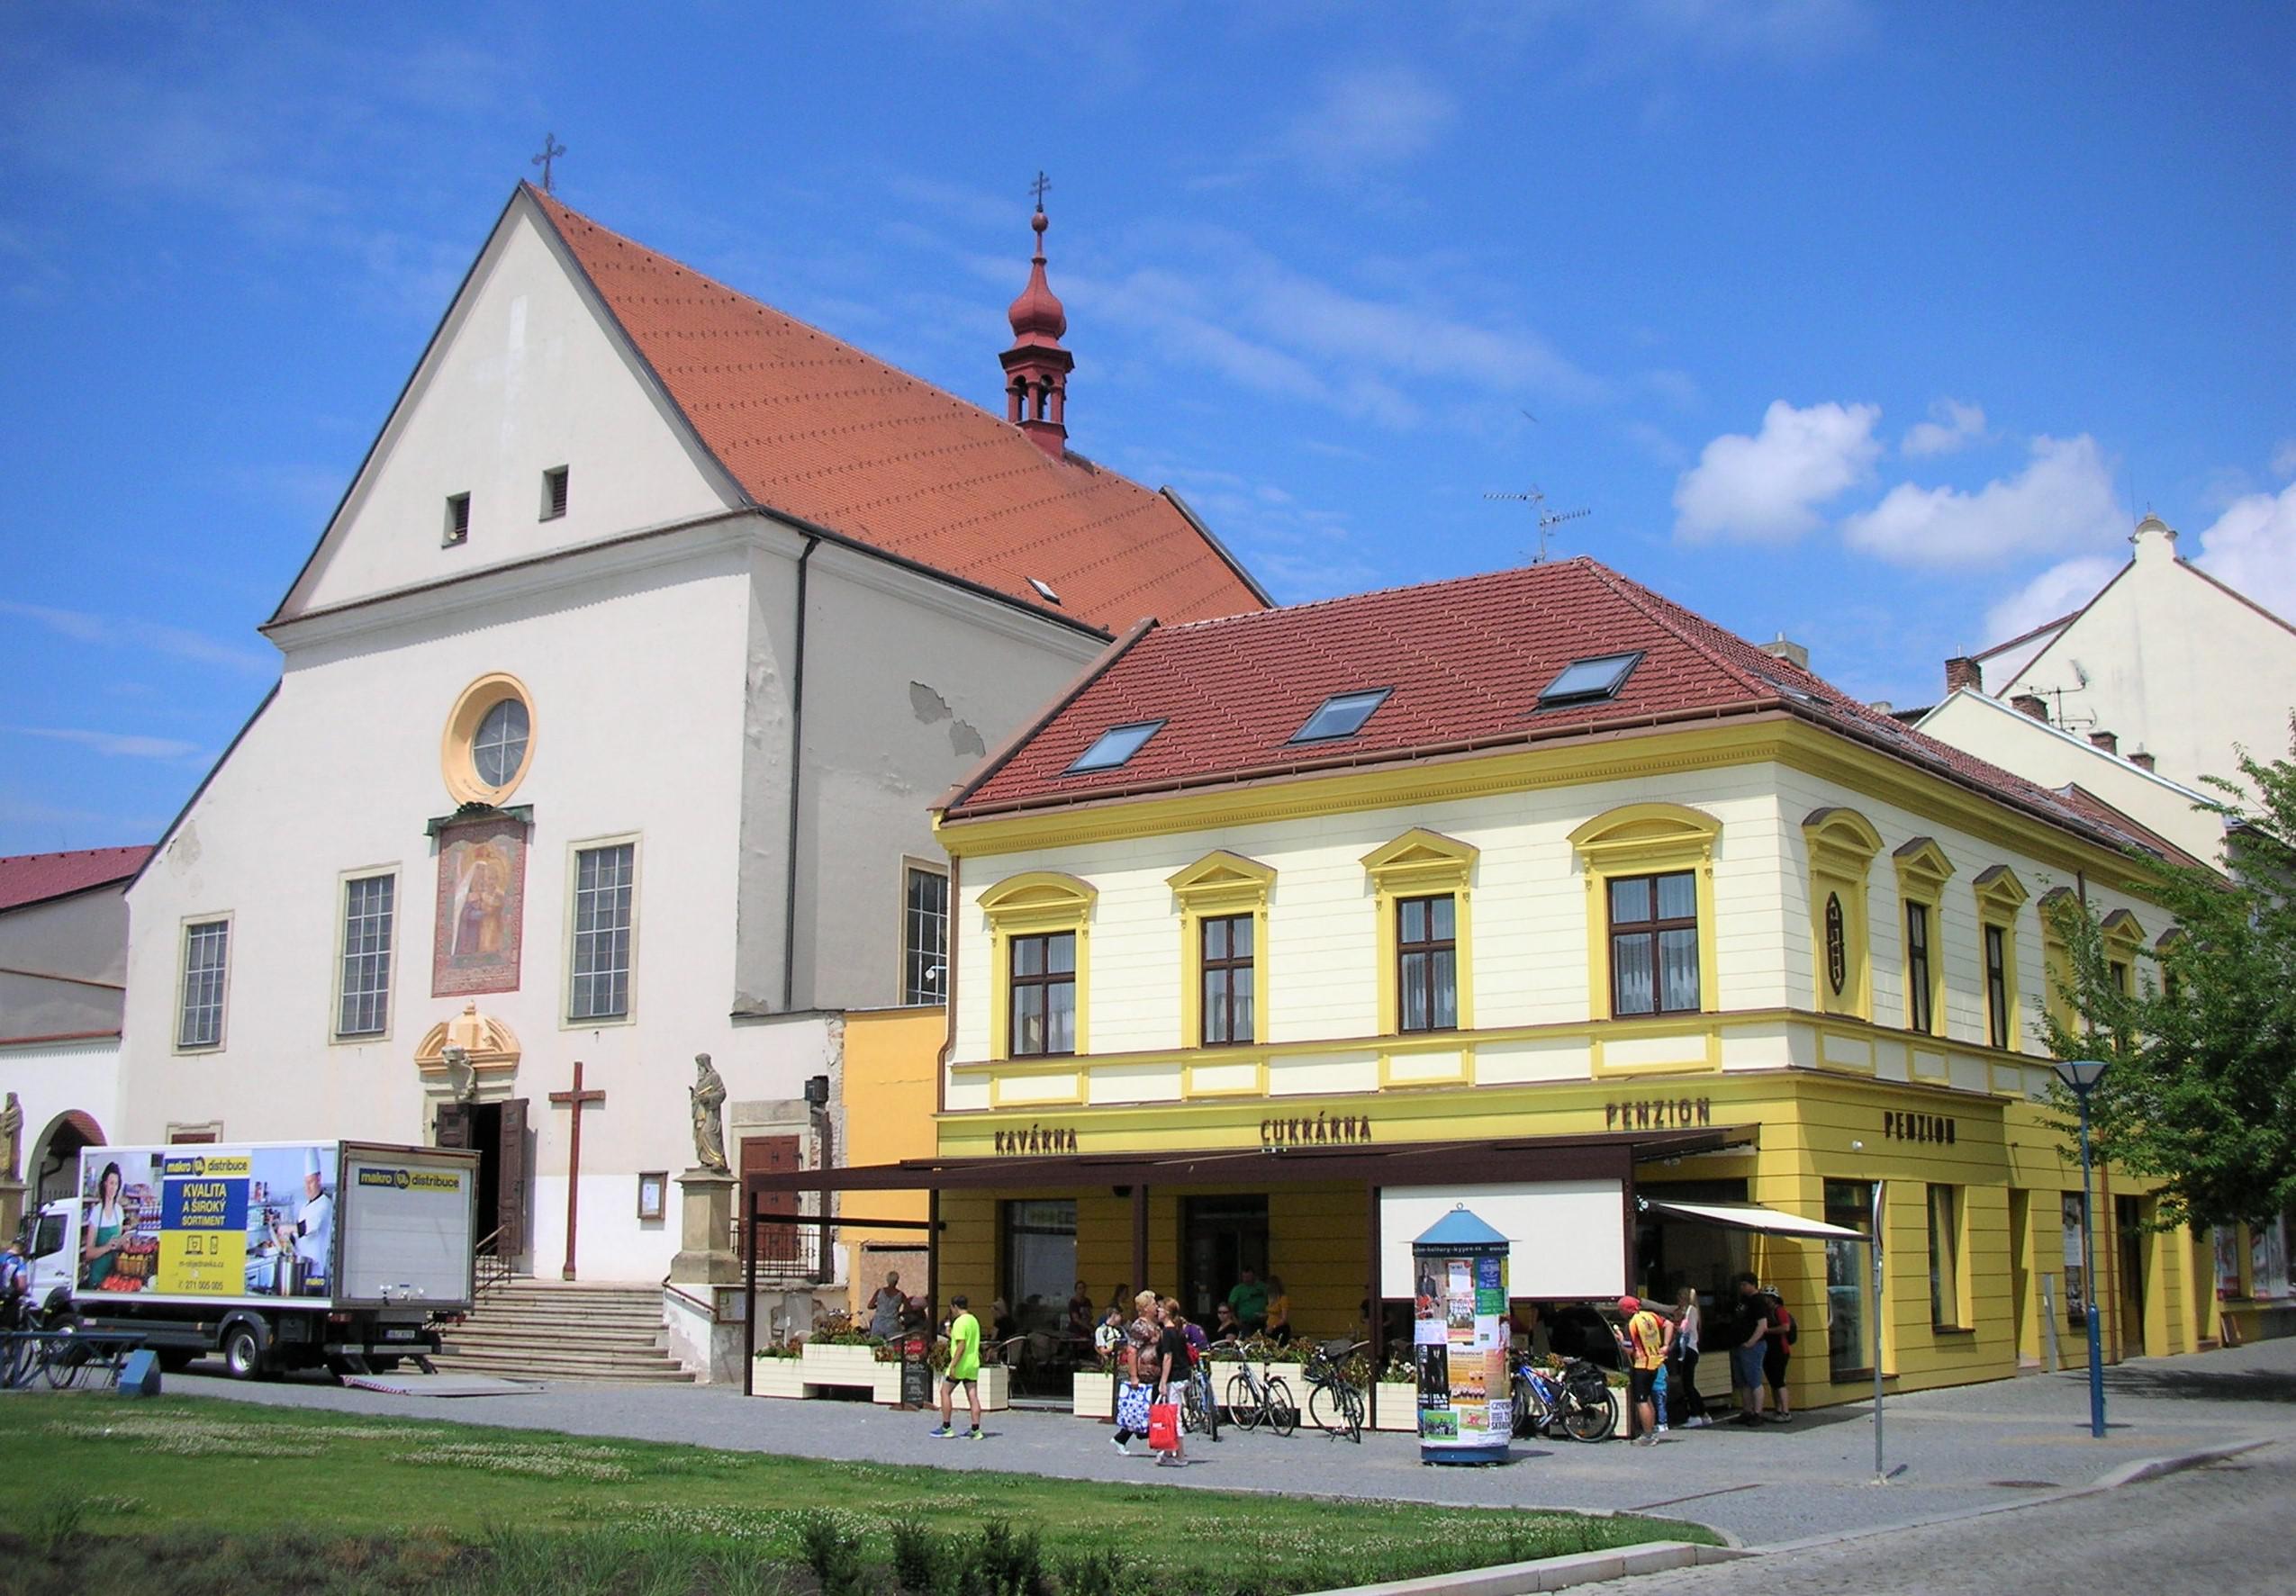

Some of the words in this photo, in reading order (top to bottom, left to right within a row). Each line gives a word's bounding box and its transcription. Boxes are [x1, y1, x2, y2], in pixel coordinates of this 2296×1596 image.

[1605, 1097, 1710, 1131] PENZION
[1261, 1111, 1371, 1145] CUKRÁRNA
[1884, 1111, 1956, 1144] PENZION
[995, 1123, 1078, 1155] KAVÁRNA
[167, 1161, 192, 1173] makro
[208, 1159, 248, 1171] distribuce
[361, 1172, 393, 1184] makro
[411, 1174, 459, 1188] distribuce
[183, 1183, 226, 1197] KVALITA
[183, 1201, 189, 1213] A
[192, 1197, 226, 1213] ŠIROKÝ
[182, 1215, 225, 1226] SORTIMENT
